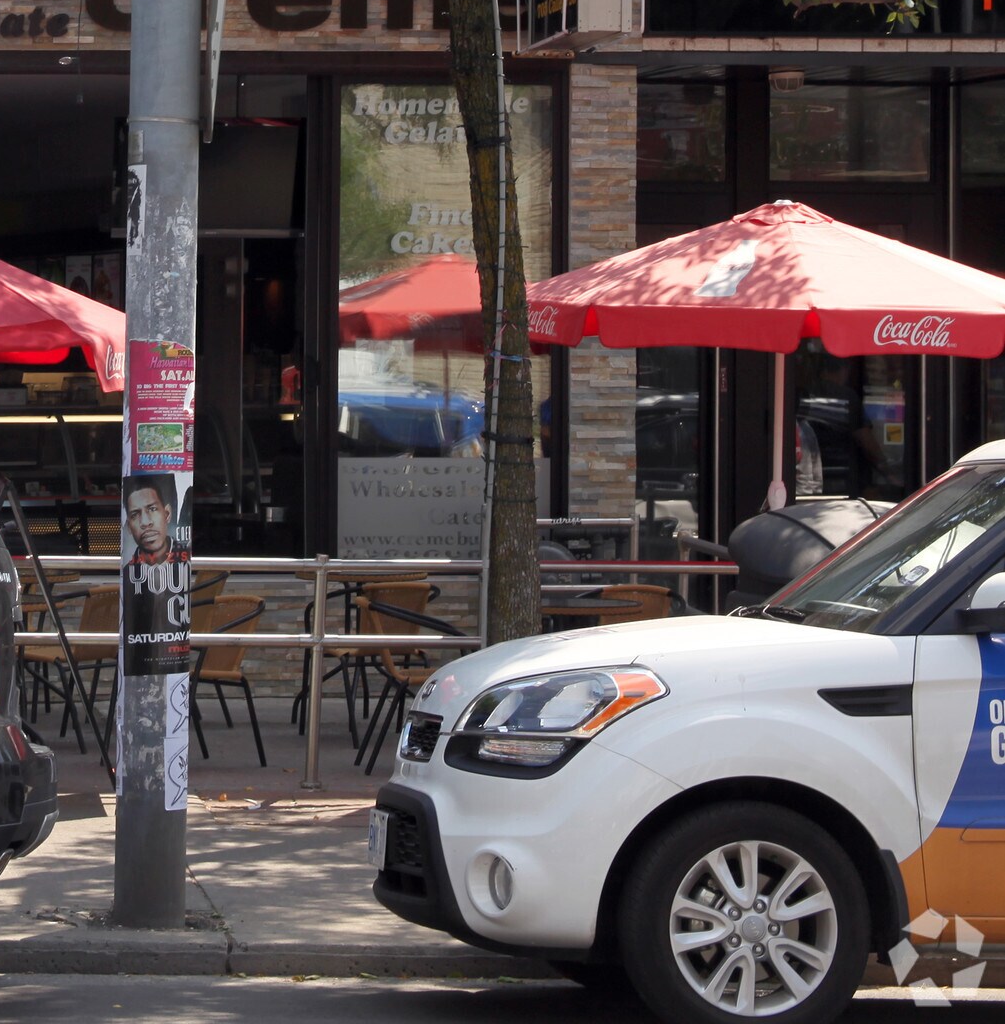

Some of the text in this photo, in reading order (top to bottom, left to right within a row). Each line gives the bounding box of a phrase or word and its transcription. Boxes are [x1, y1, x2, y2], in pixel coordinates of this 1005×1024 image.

[873, 314, 956, 348] Coca-Cola
[128, 631, 184, 644] SATURDAY
[990, 699, 1005, 725] O
